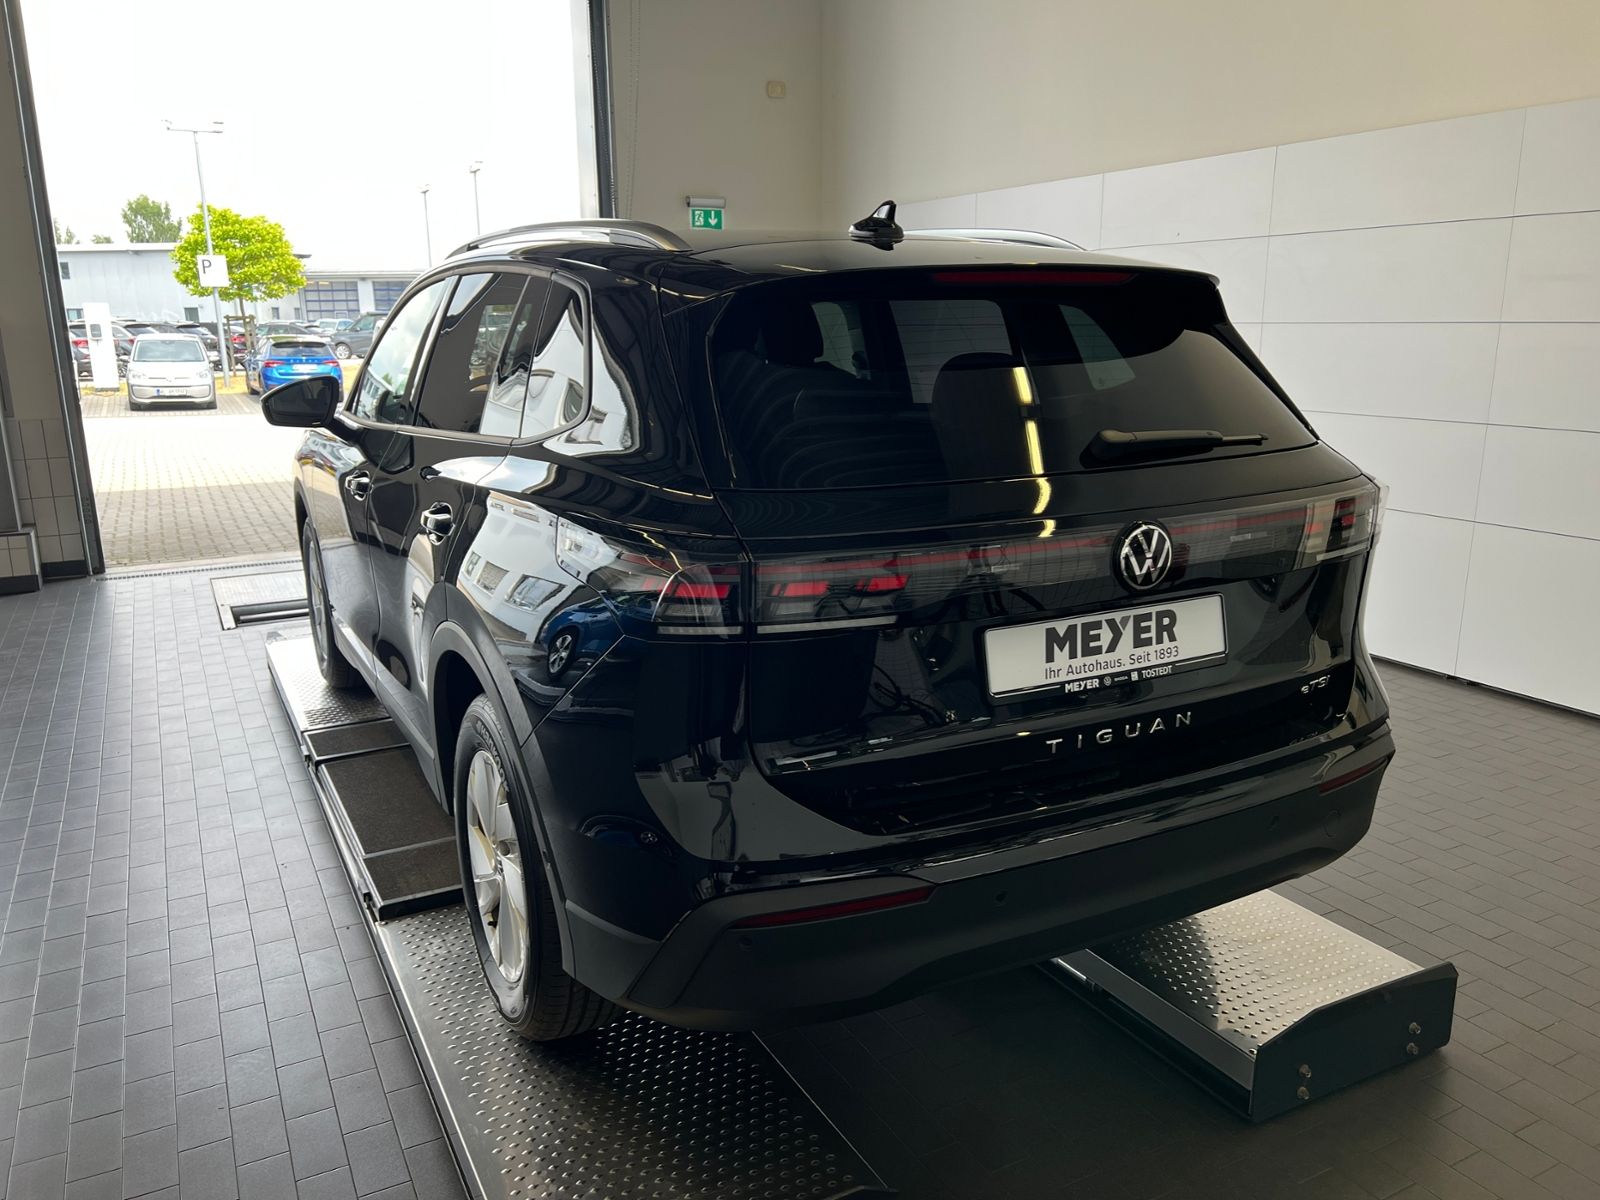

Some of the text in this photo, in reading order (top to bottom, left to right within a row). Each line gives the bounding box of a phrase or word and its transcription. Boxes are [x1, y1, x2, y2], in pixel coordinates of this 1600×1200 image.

[201, 259, 212, 274] P
[1045, 609, 1178, 664] MEYER
[1045, 645, 1180, 680] Ihr Autohaus. Seit 1893
[1064, 678, 1100, 693] MEYER
[1141, 665, 1173, 679] TOSTEDT
[1046, 711, 1192, 754] TIGUAN
